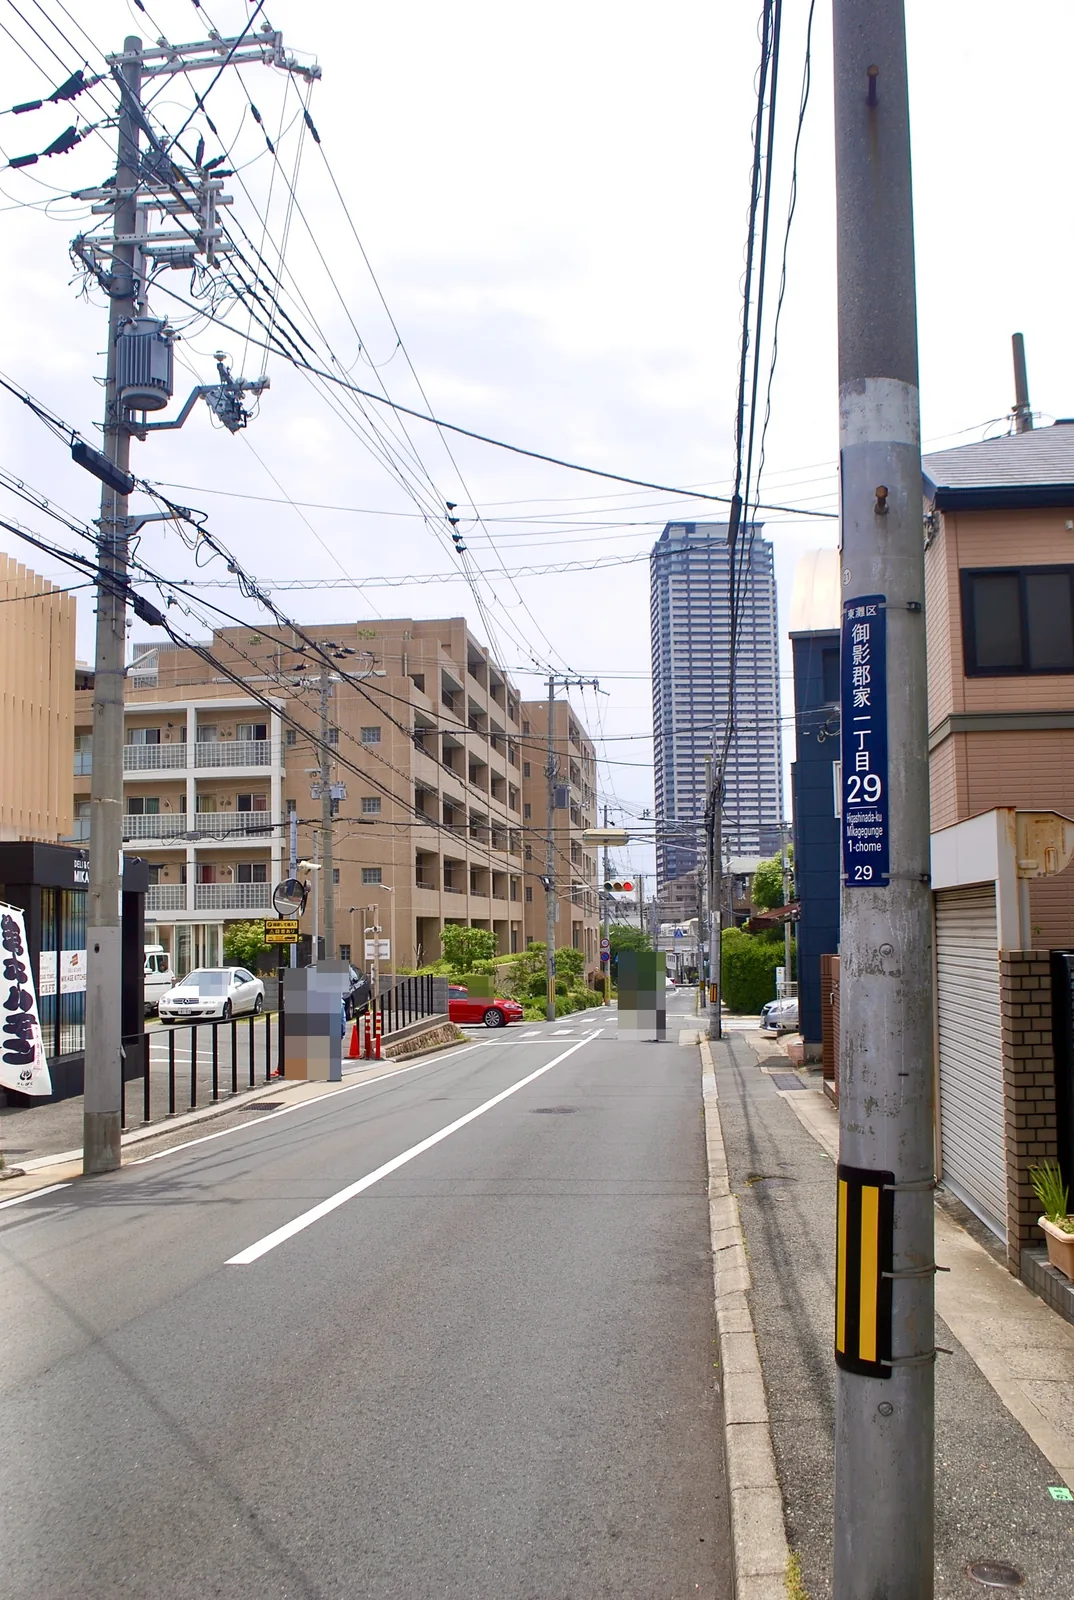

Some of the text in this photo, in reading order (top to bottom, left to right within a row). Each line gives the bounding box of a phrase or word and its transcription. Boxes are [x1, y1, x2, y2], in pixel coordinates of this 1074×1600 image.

[847, 604, 877, 620] 東灘区
[851, 623, 872, 772] 御影郡家一丁目
[847, 774, 882, 803] 29
[846, 811, 883, 825] Higashinada-ku
[846, 825, 883, 838] Mikagegunge
[847, 840, 882, 852] 1-chome
[854, 865, 873, 880] 29
[41, 983, 55, 993] CAFE
